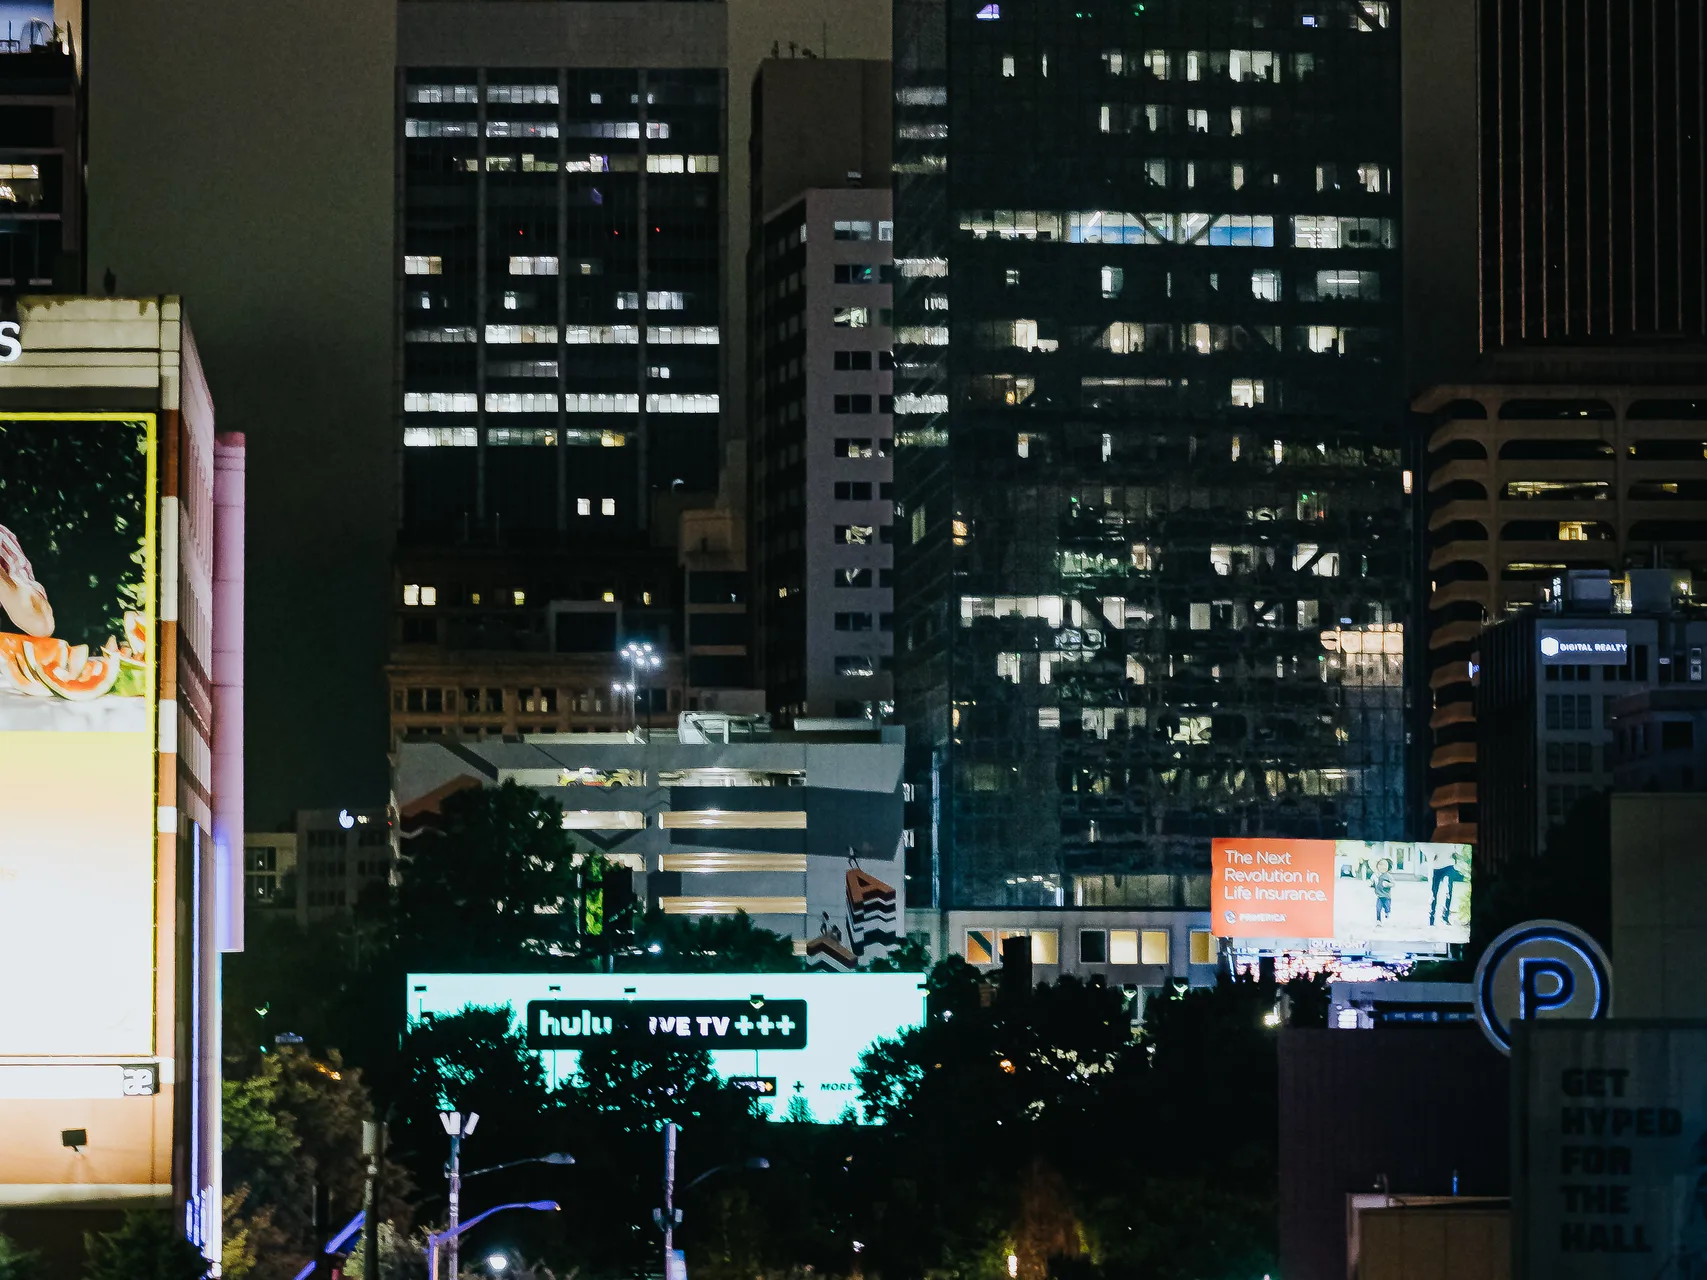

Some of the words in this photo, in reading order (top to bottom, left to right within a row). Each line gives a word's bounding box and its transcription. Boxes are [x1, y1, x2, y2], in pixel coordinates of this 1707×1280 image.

[1559, 643, 1593, 652] DIGITAL
[1594, 643, 1628, 652] REALTY
[1224, 849, 1253, 865] The
[1256, 850, 1292, 866] Next
[1224, 867, 1303, 883] Revolution
[1306, 869, 1320, 884] in
[1224, 885, 1252, 901] Life
[1255, 887, 1328, 902] Insurance.
[1518, 957, 1575, 1020] P
[539, 1009, 612, 1036] hulu
[696, 1016, 730, 1036] TV
[820, 1082, 854, 1092] MORE
[1561, 1068, 1630, 1098] GET
[1561, 1106, 1684, 1137] HYPED
[1561, 1145, 1632, 1175] FOR
[1560, 1185, 1631, 1214] THE
[1560, 1223, 1652, 1253] HALL
